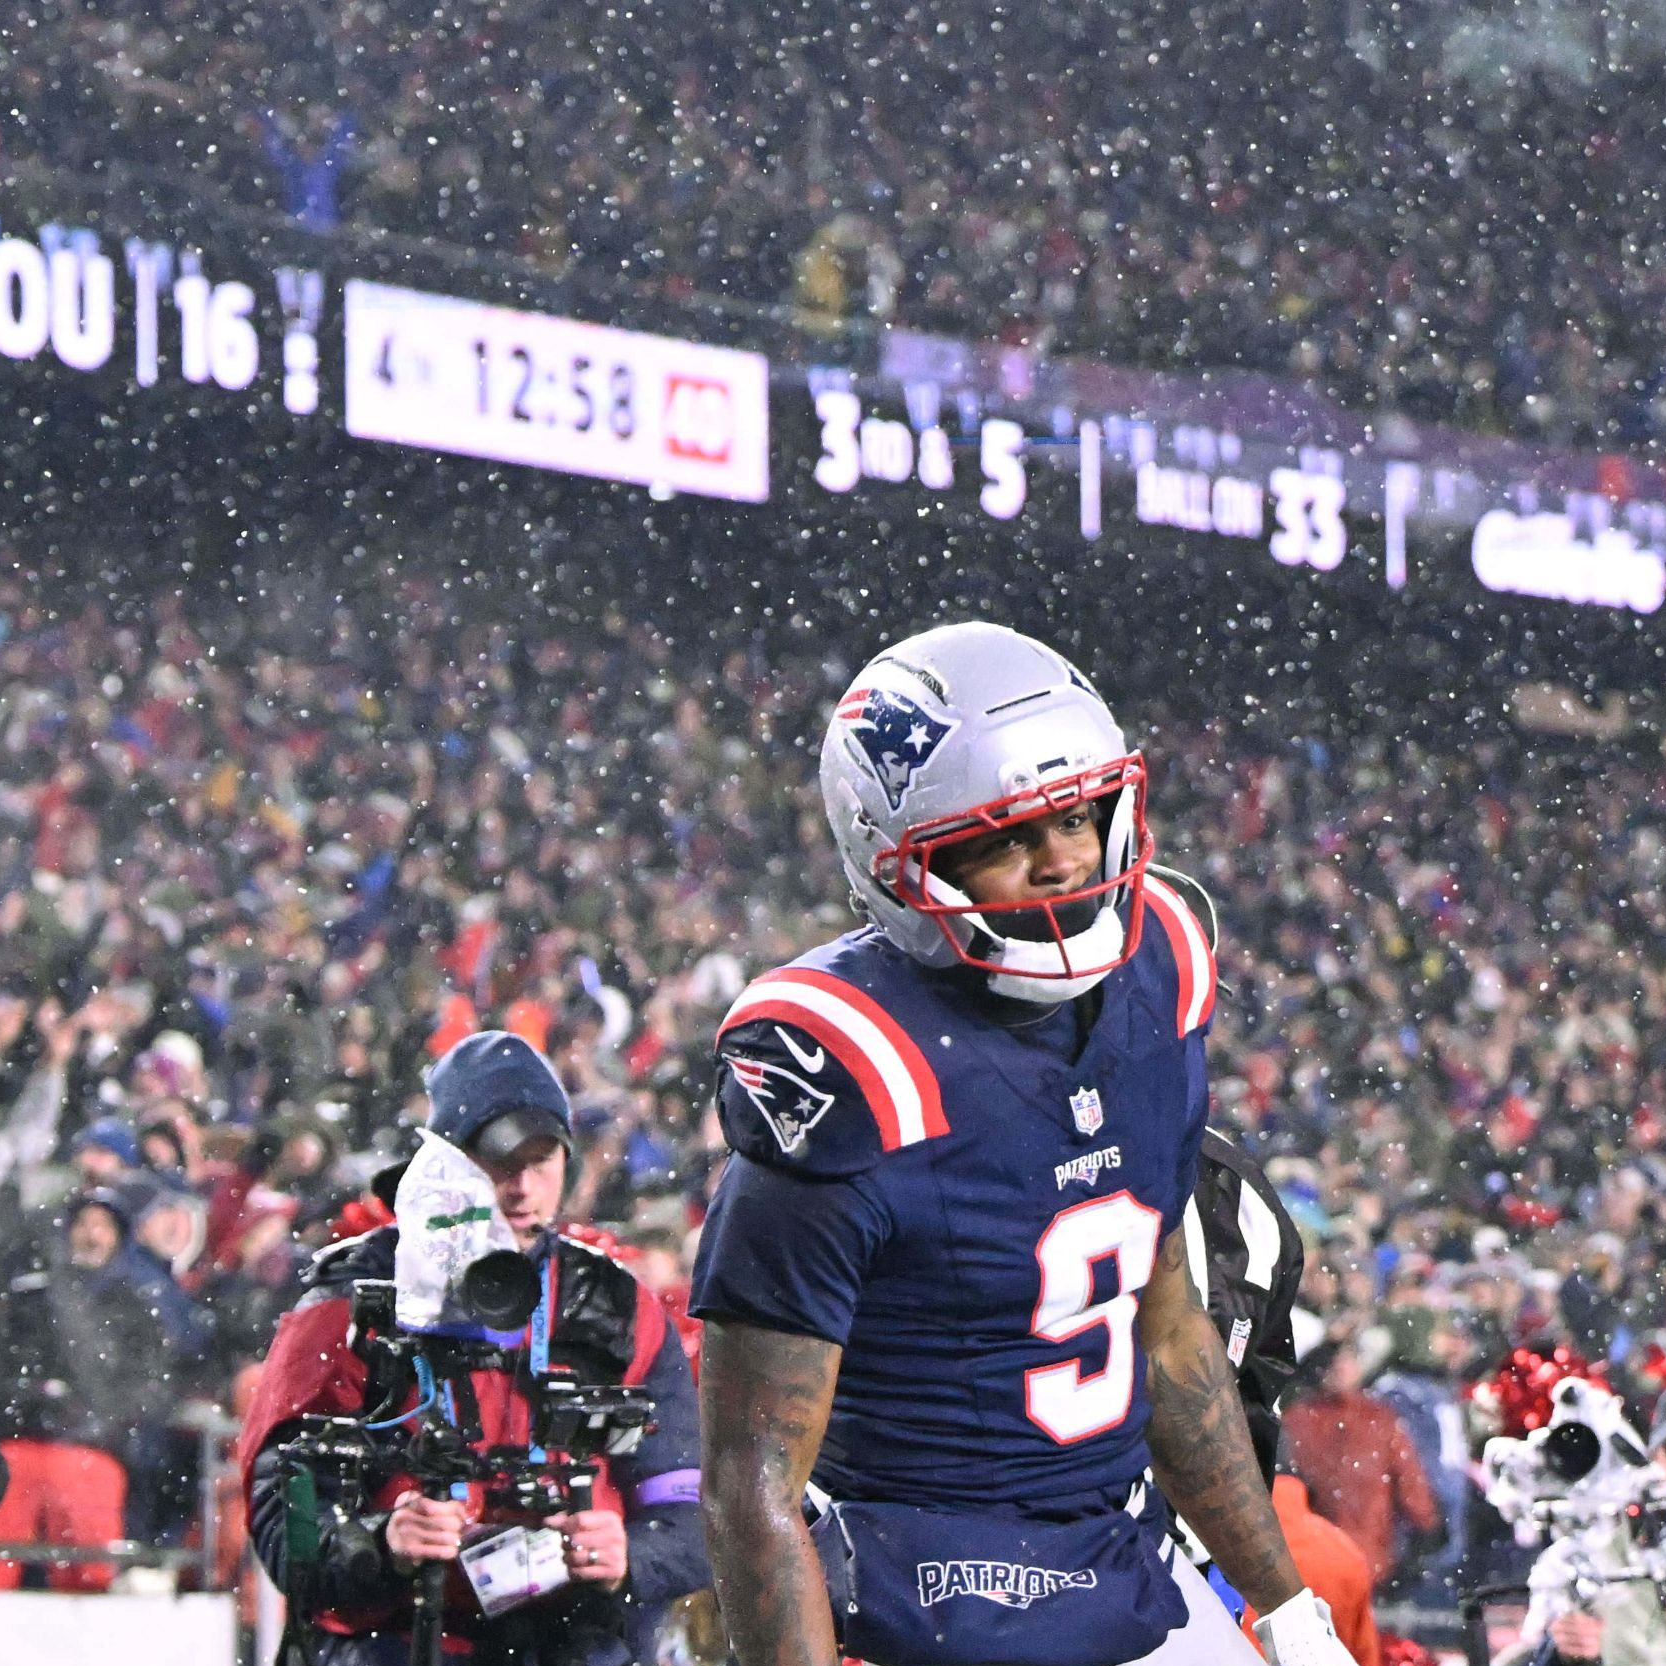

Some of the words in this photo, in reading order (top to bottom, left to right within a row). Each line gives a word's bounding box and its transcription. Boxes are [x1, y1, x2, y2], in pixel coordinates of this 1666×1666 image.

[173, 273, 259, 390] 16
[470, 333, 636, 441] 12:58
[980, 419, 1027, 519] 5
[1269, 467, 1346, 570] 33
[1054, 1145, 1122, 1191] PATRIOTS
[1025, 1188, 1163, 1445] 9
